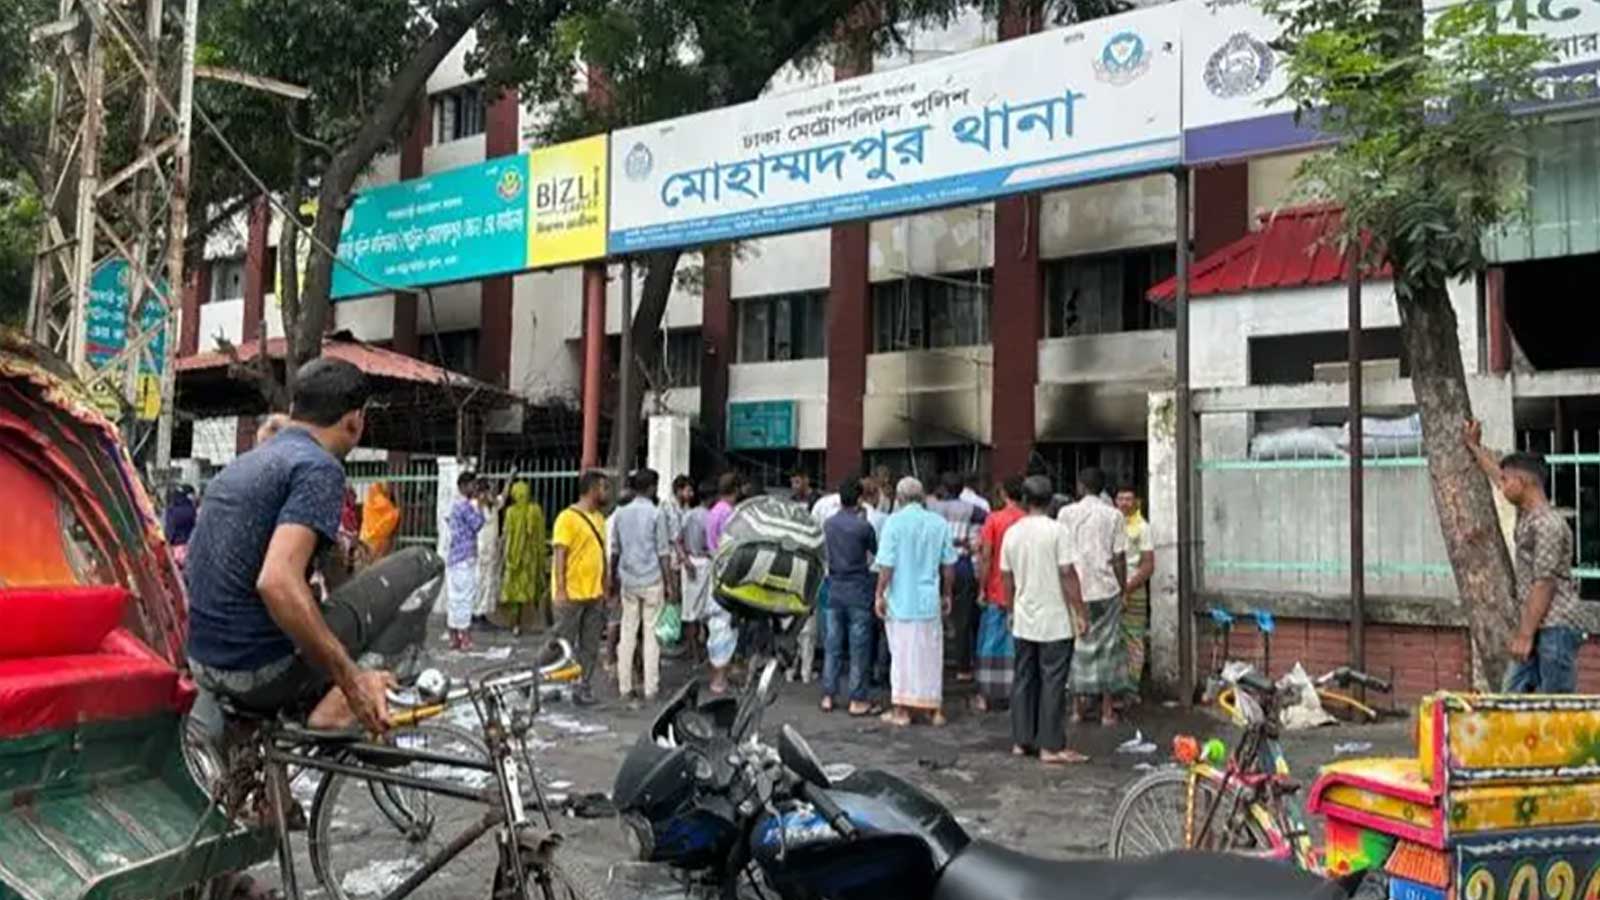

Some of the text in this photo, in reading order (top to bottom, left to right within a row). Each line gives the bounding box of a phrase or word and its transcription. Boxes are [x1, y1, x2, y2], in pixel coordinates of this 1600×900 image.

[660, 124, 932, 207] মোহাম্মদপুর
[952, 88, 1086, 151] থানা
[743, 88, 970, 149] ঢাকা মেট্রোপলিটন পুলিশ
